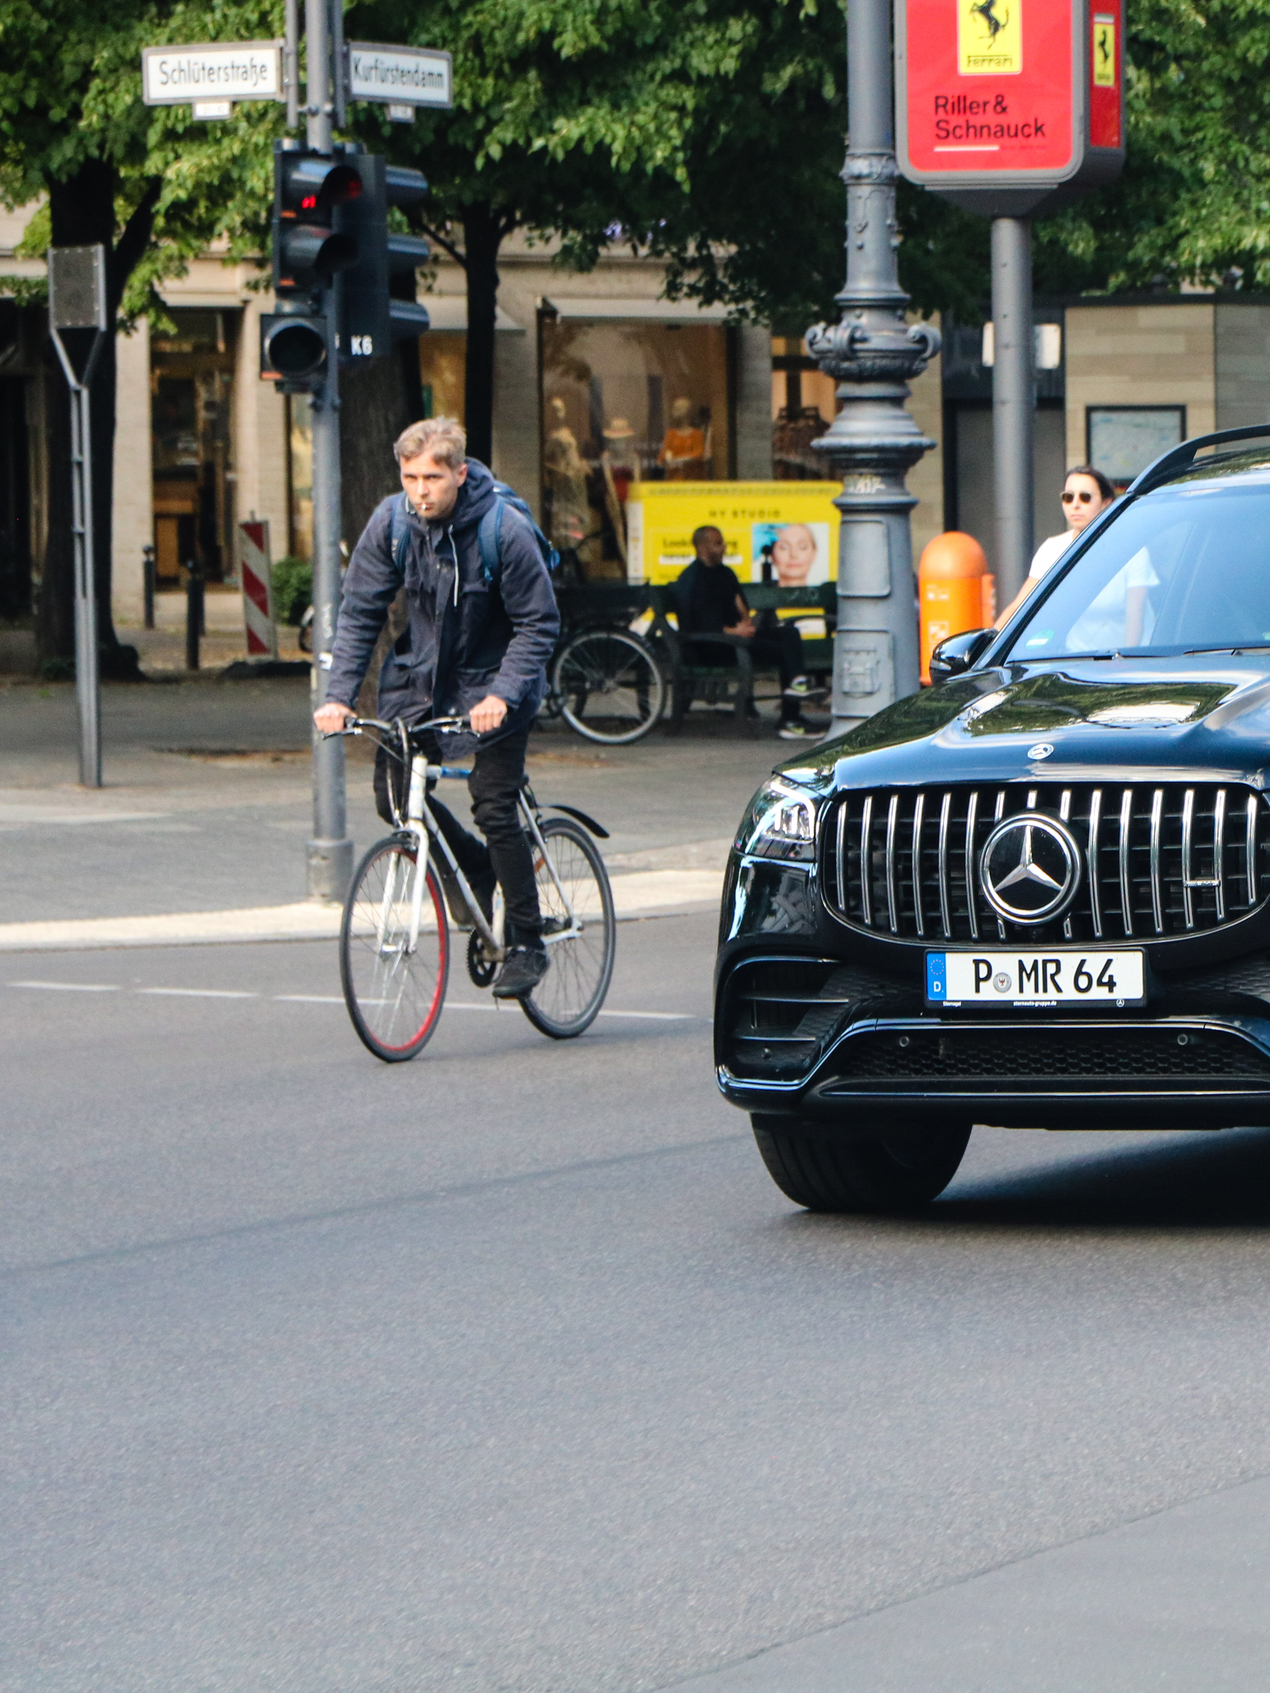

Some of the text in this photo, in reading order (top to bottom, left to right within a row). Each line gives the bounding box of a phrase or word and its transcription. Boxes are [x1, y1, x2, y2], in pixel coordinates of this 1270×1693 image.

[967, 55, 1013, 68] Ferrari
[158, 59, 269, 87] Schlüterstraße
[353, 56, 445, 90] Kurfürstendamm
[935, 118, 1046, 140] Schnauck
[350, 335, 373, 356] K6
[933, 981, 942, 993] D
[973, 958, 1117, 994] P MR 64
